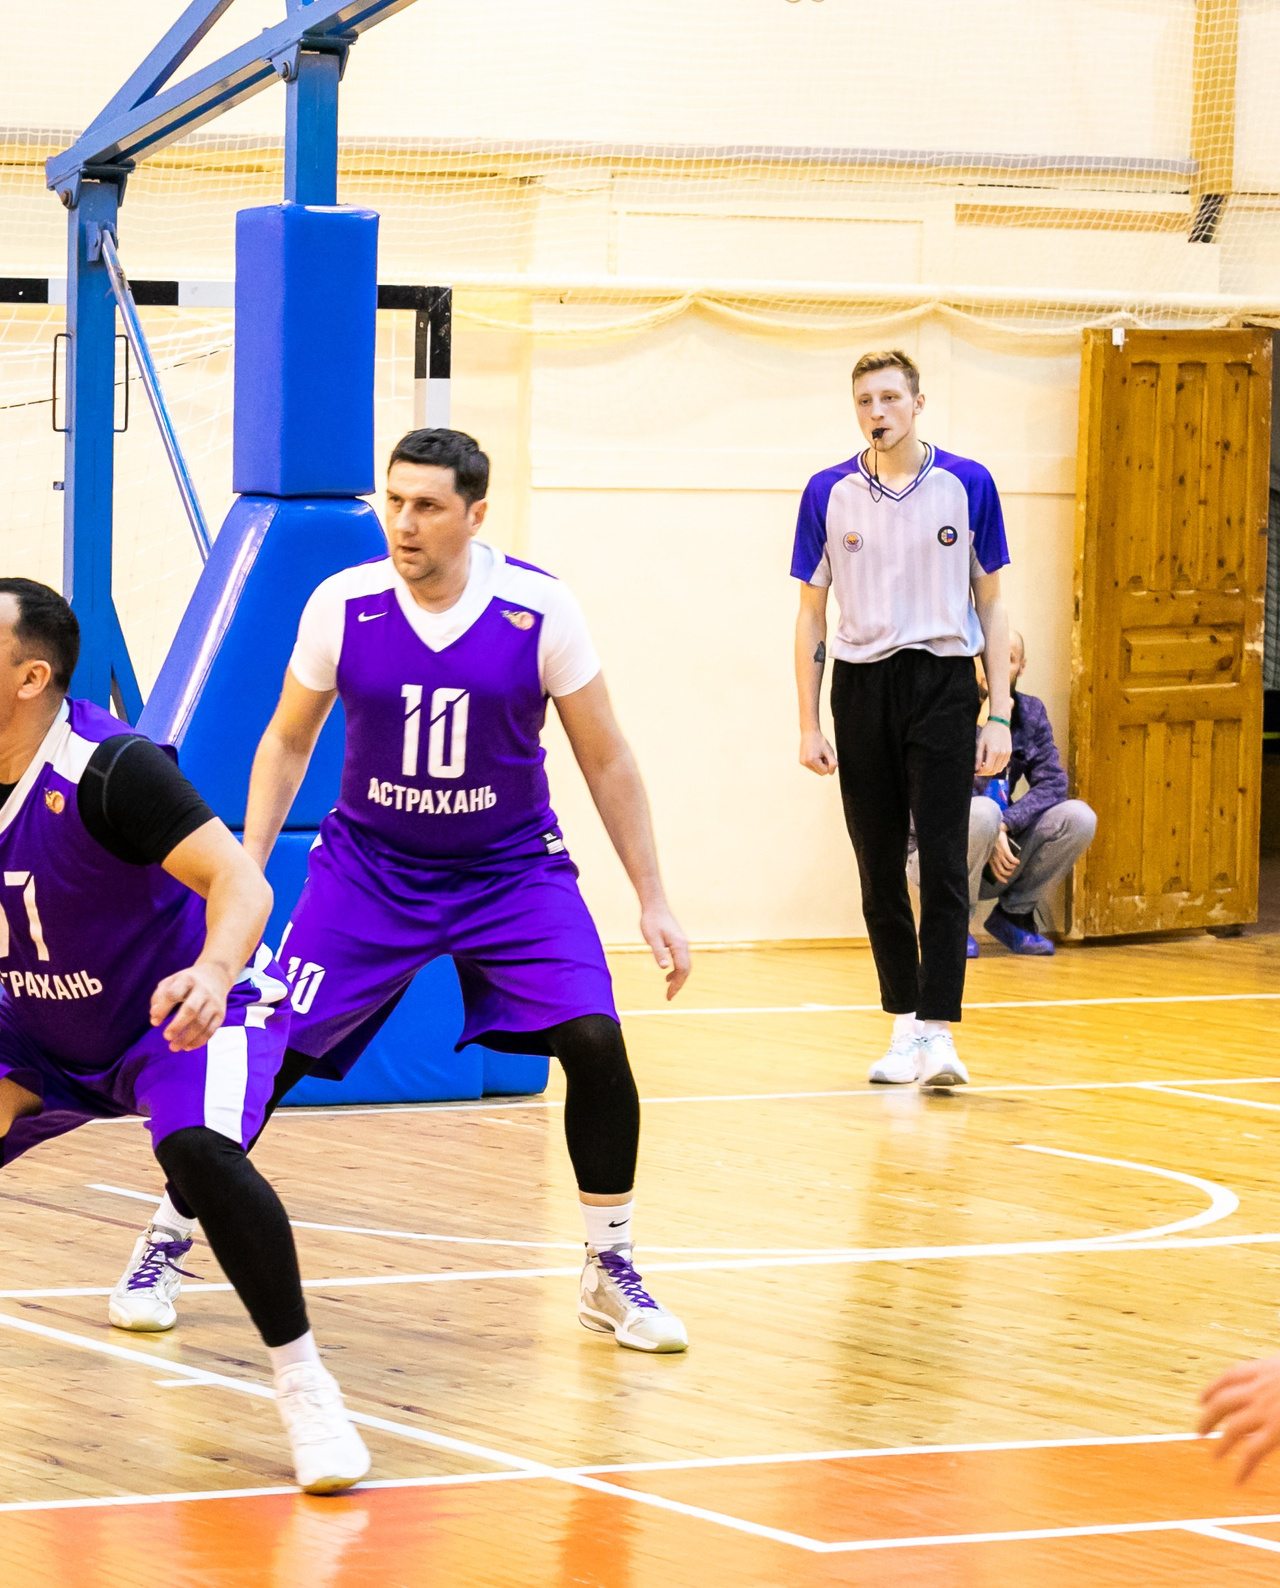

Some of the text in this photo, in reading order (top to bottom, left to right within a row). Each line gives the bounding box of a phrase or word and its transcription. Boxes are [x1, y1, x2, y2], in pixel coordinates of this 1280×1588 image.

[401, 684, 470, 779] 10
[367, 777, 497, 815] АСТРАХАНЬ
[286, 956, 326, 1015] 10
